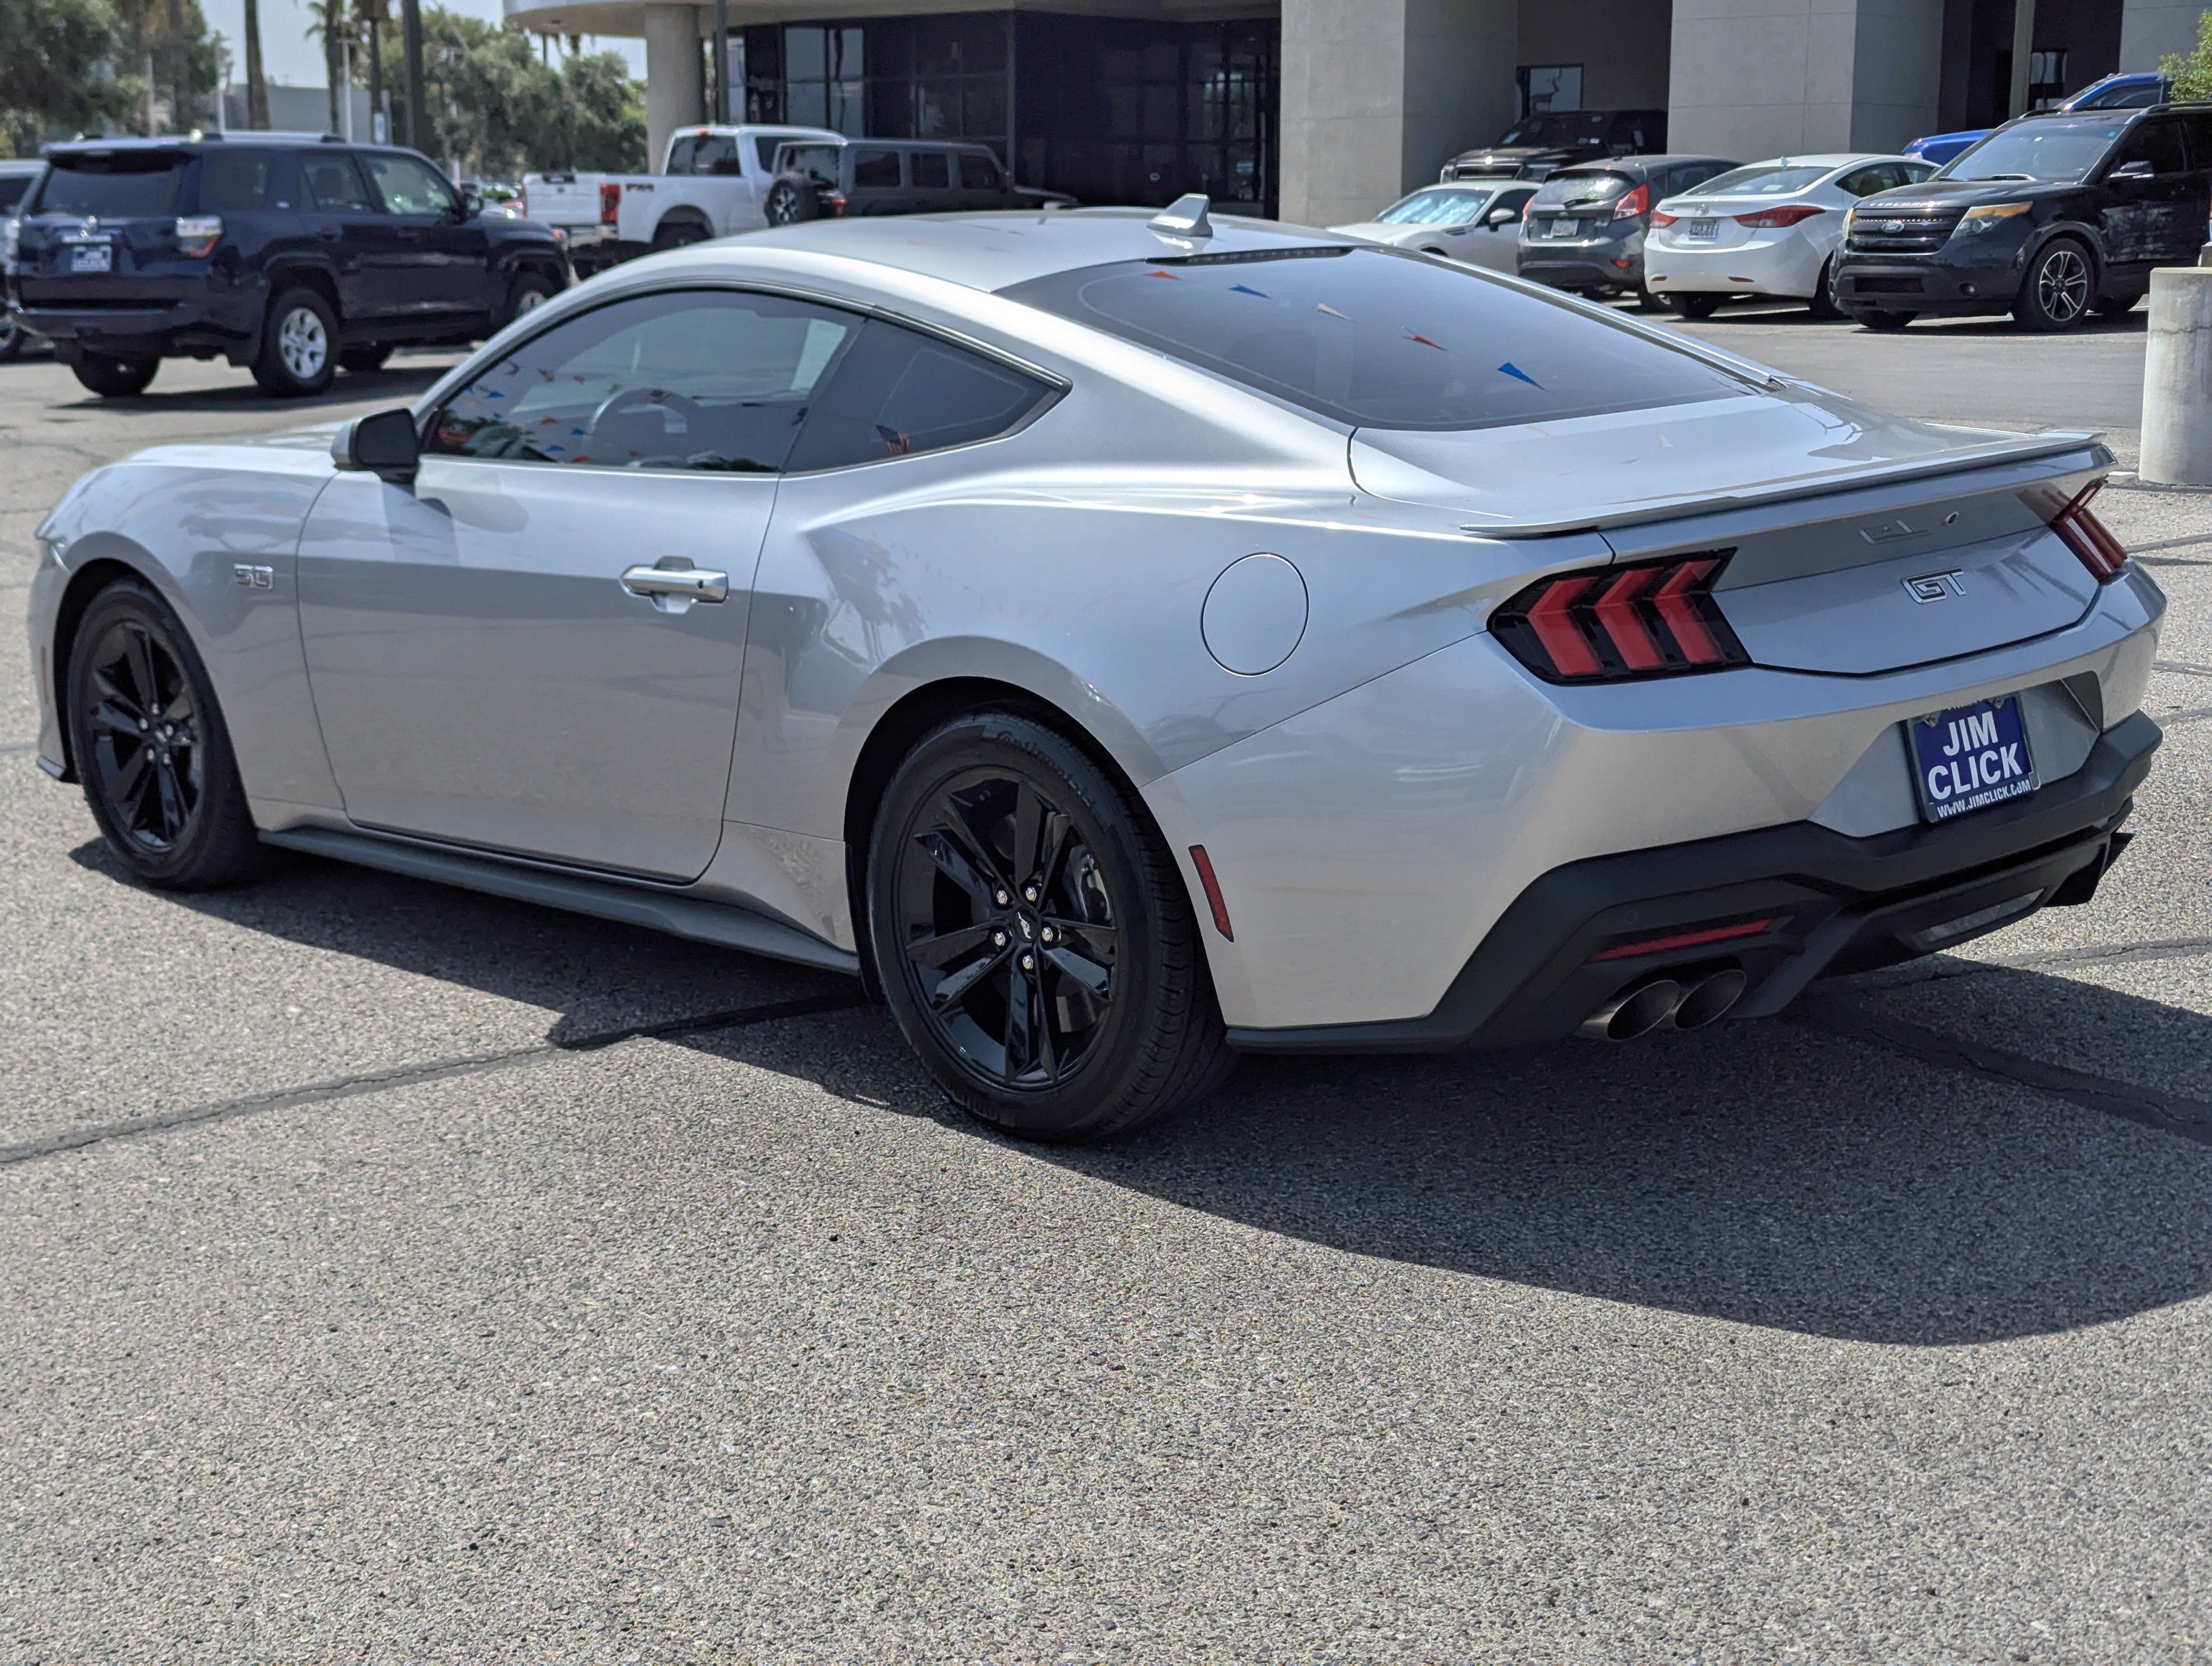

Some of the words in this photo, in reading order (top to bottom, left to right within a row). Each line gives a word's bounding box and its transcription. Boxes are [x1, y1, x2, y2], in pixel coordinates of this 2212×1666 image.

[1901, 567, 1966, 604] GT
[1943, 711, 1998, 757] JIM
[1928, 742, 2023, 800] CLICK
[1937, 779, 2031, 818] WWW.JIMCLICK.COM
